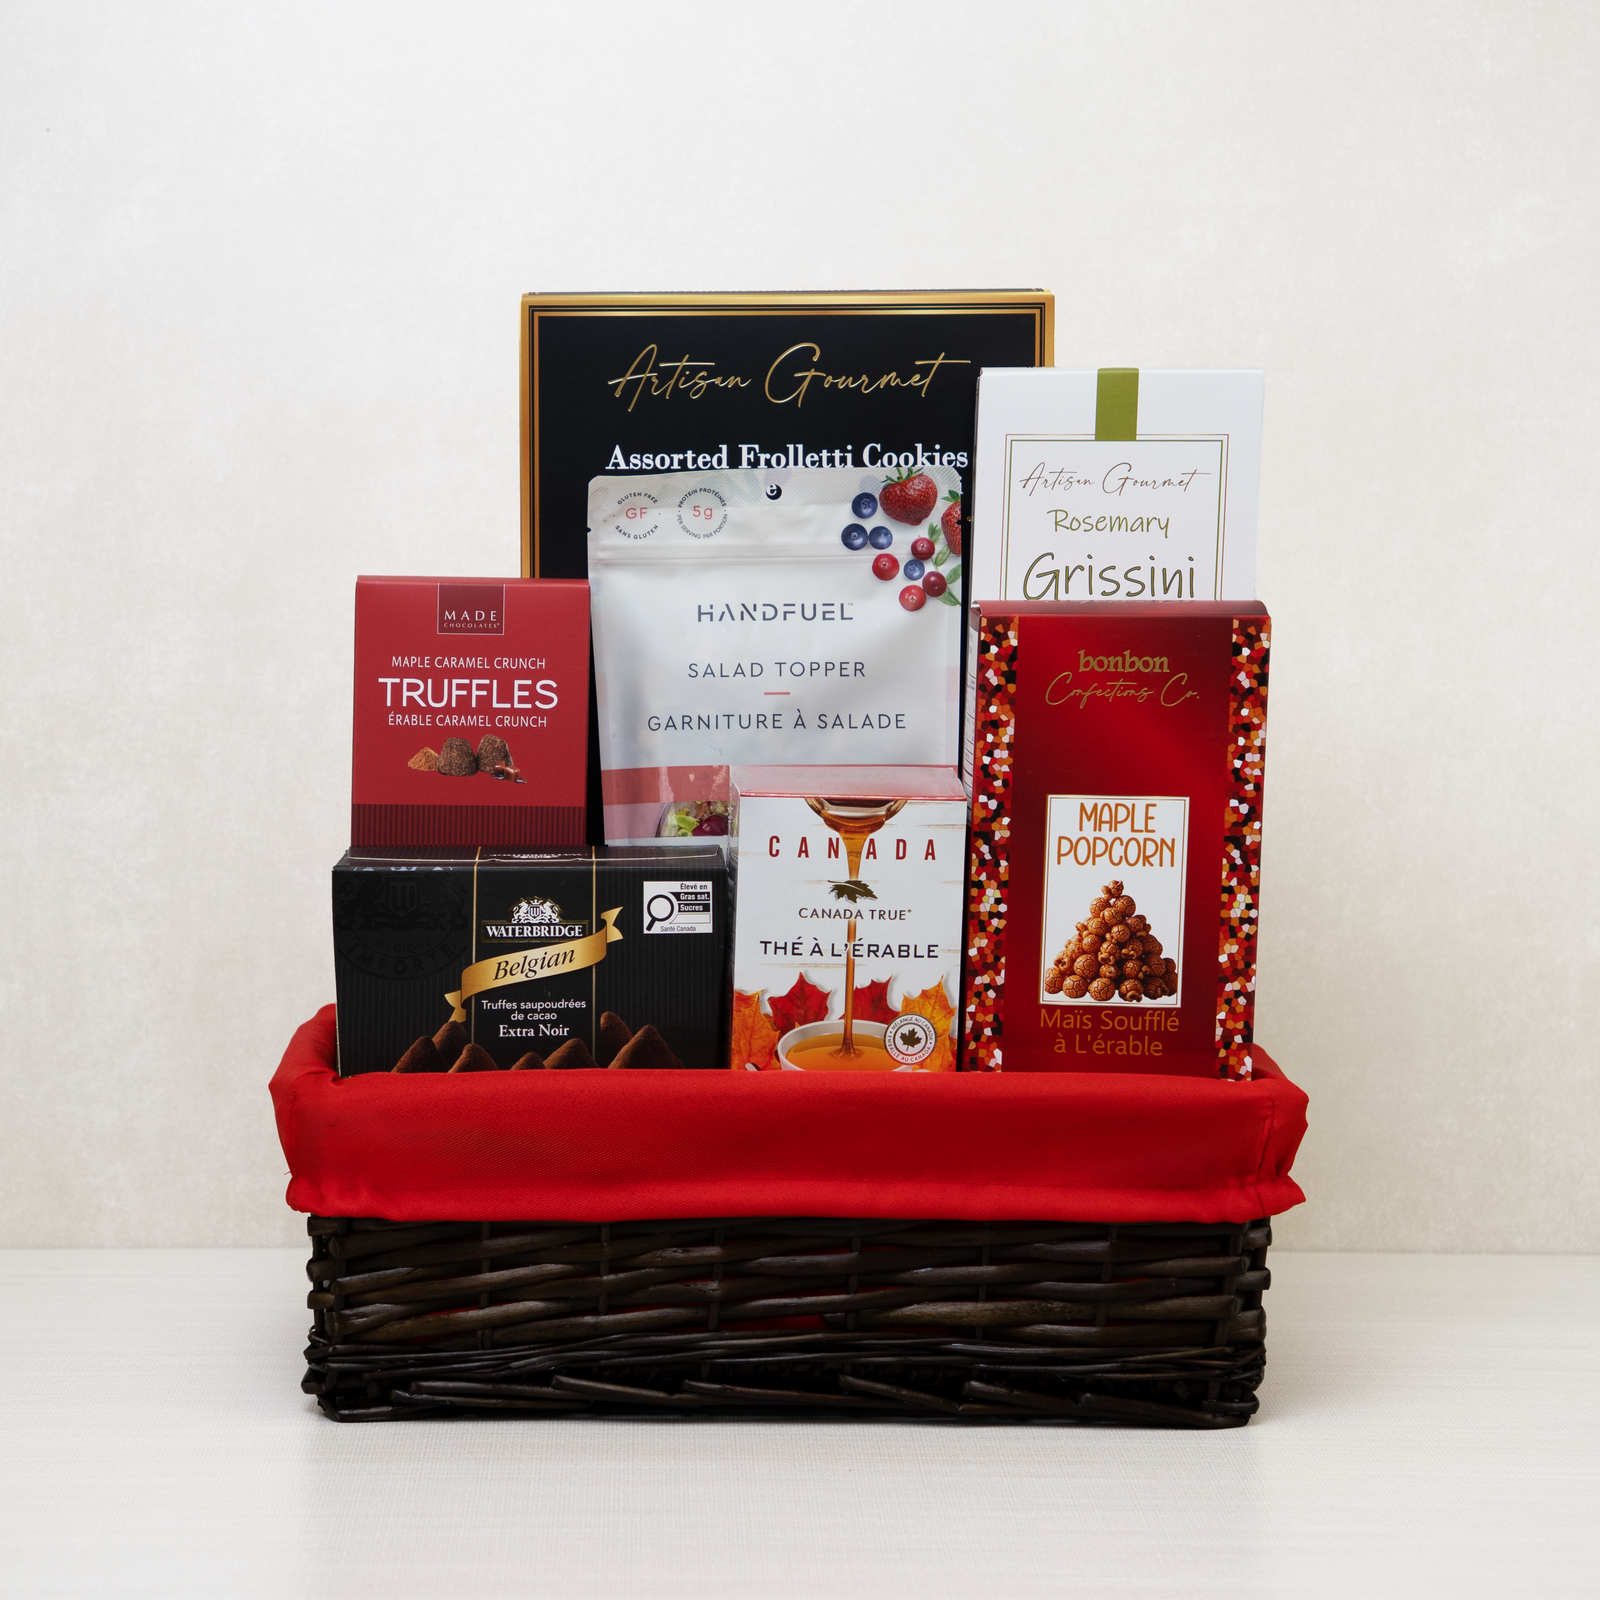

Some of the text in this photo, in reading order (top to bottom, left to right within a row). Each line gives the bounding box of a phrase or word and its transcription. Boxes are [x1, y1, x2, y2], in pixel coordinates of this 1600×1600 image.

[608, 342, 971, 411] Artisan Gourmet
[605, 443, 968, 469] Assorted Frolletti Cookies
[1020, 462, 1211, 496] Artisan Gourmet
[618, 492, 658, 505] GLUTEN FREE
[678, 488, 727, 508] PROTEIN PROTÉINES
[626, 507, 648, 519] GF
[693, 506, 713, 520] 5g
[615, 524, 659, 540] SANS GLUTEN
[681, 524, 701, 539] SERVING
[713, 514, 728, 535] PORTION
[1047, 509, 1169, 538] Rosemary
[1023, 552, 1194, 600] Grissini
[444, 610, 497, 621] MADE
[392, 656, 546, 669] MAPLE CARAMEL CRUNCH
[688, 662, 866, 678] SALAD TOPPER
[1078, 650, 1170, 672] bonbon
[378, 678, 558, 709] TRUFFLES
[1046, 672, 1199, 708] Confections Co.
[388, 711, 547, 728] ÉRABLE CARAMEL CRUNCH
[648, 709, 906, 731] GARNITURE À SALADE
[1079, 802, 1157, 833] MAPLE
[768, 836, 936, 861] CANADA
[1057, 836, 1176, 867] POPCORN
[680, 882, 697, 890] Élevé
[799, 908, 863, 920] CANADA
[486, 926, 583, 937] WATERBRIDGE
[373, 937, 432, 954] BELGIQUE
[760, 936, 939, 959] THÉ À L'ÉRABLE
[492, 949, 576, 982] Belgian
[482, 999, 586, 1013] Truffes saupoudrées
[511, 1011, 557, 1021] de cacao
[1040, 1009, 1179, 1031] Maïs Soufflé
[499, 1024, 569, 1038] Extra Noir
[921, 1021, 933, 1040] CANADA
[910, 1046, 931, 1062] CANADA
[1054, 1034, 1163, 1056] à L'érable
